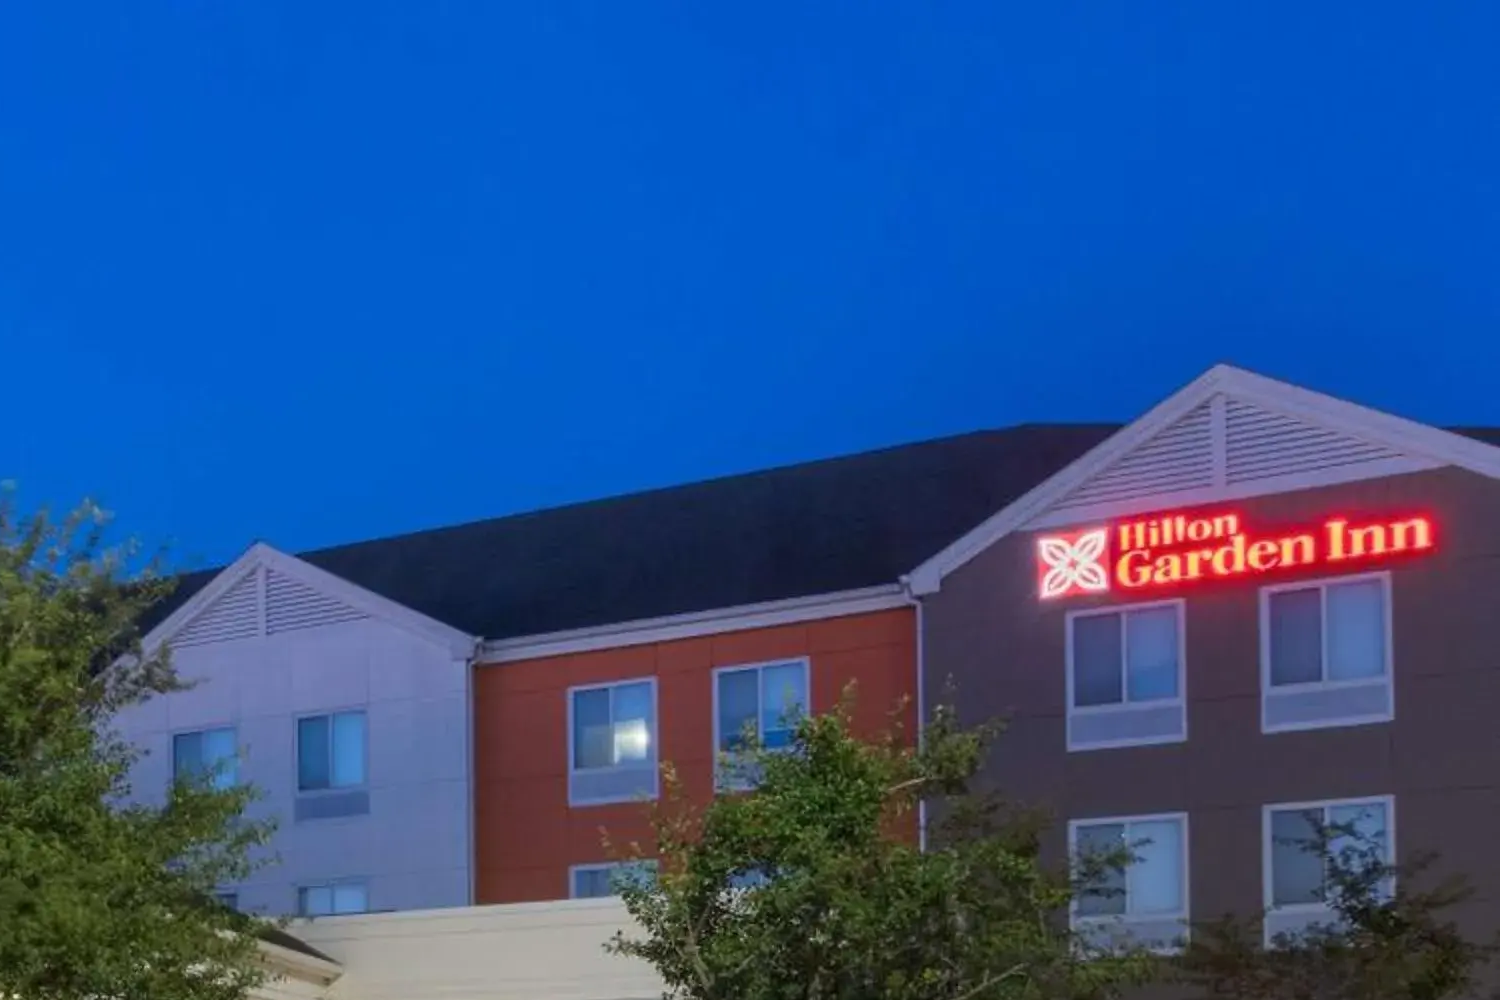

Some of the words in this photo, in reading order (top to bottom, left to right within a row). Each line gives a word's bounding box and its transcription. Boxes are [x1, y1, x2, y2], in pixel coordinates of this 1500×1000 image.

[1116, 534, 1315, 587] Garden
[1324, 517, 1432, 561] Inn
[1119, 514, 1238, 550] Hilton
